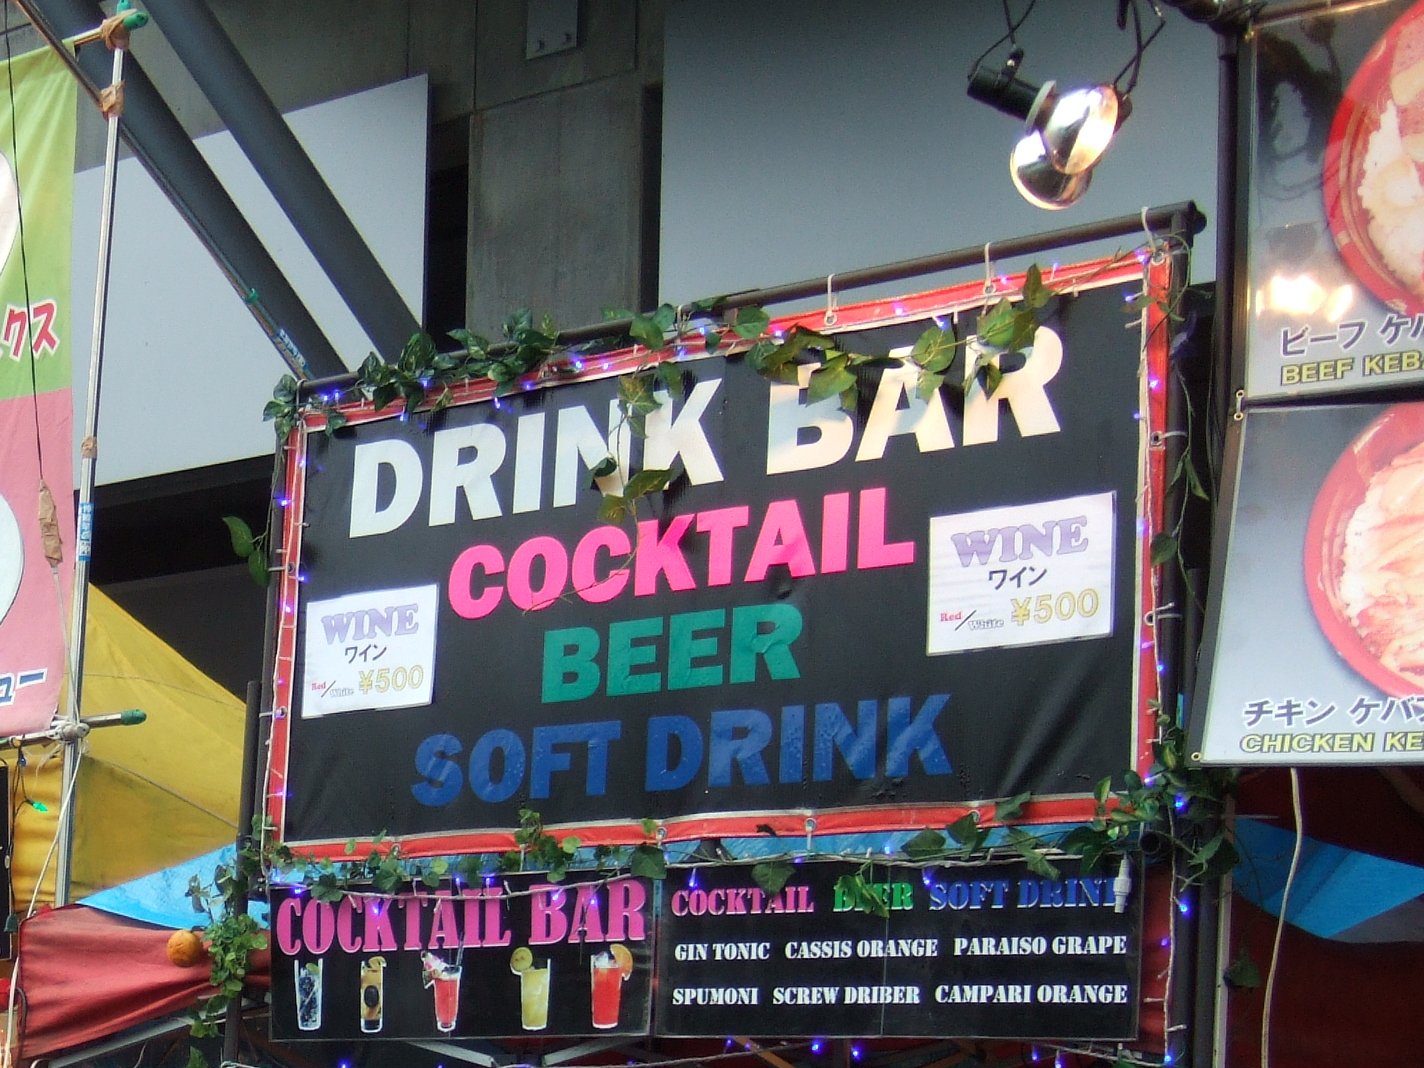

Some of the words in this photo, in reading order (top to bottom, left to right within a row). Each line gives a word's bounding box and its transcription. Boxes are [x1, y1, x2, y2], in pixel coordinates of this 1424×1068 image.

[1280, 319, 1369, 357] ビーフ
[1280, 356, 1355, 387] BEEF
[1361, 349, 1424, 377] KEB
[347, 376, 726, 540] DRINK
[766, 323, 1066, 477] BAR
[447, 487, 916, 621] COCKTAIL
[950, 515, 1089, 568] WINE
[988, 565, 1048, 591] ワイン
[320, 603, 420, 645] WINE
[1009, 587, 1100, 627] ¥500
[344, 643, 388, 665] ワイン
[540, 600, 803, 704] BEER
[358, 664, 424, 695] ¥500
[1242, 694, 1338, 729] チキン
[409, 717, 622, 807] SOFT
[644, 691, 955, 792] DRINK
[1240, 730, 1375, 753] CHICKEN
[275, 892, 513, 957] COCKTAIL
[528, 876, 646, 948] BAR
[670, 884, 815, 918] COCKTAIL
[929, 879, 1010, 912] SOFT
[674, 943, 708, 962] GIN
[712, 941, 771, 962] TONIC
[784, 940, 852, 960] CASSIS
[856, 937, 939, 959] ORANGE
[953, 936, 1047, 957] PARAISO
[1051, 934, 1128, 956] GRAPE
[672, 987, 759, 1006] SPUMONI
[772, 985, 838, 1006] SCREW
[843, 985, 921, 1005] DRIBER
[934, 984, 1032, 1004] CAMPARI
[1036, 983, 1128, 1004] ORANGE
